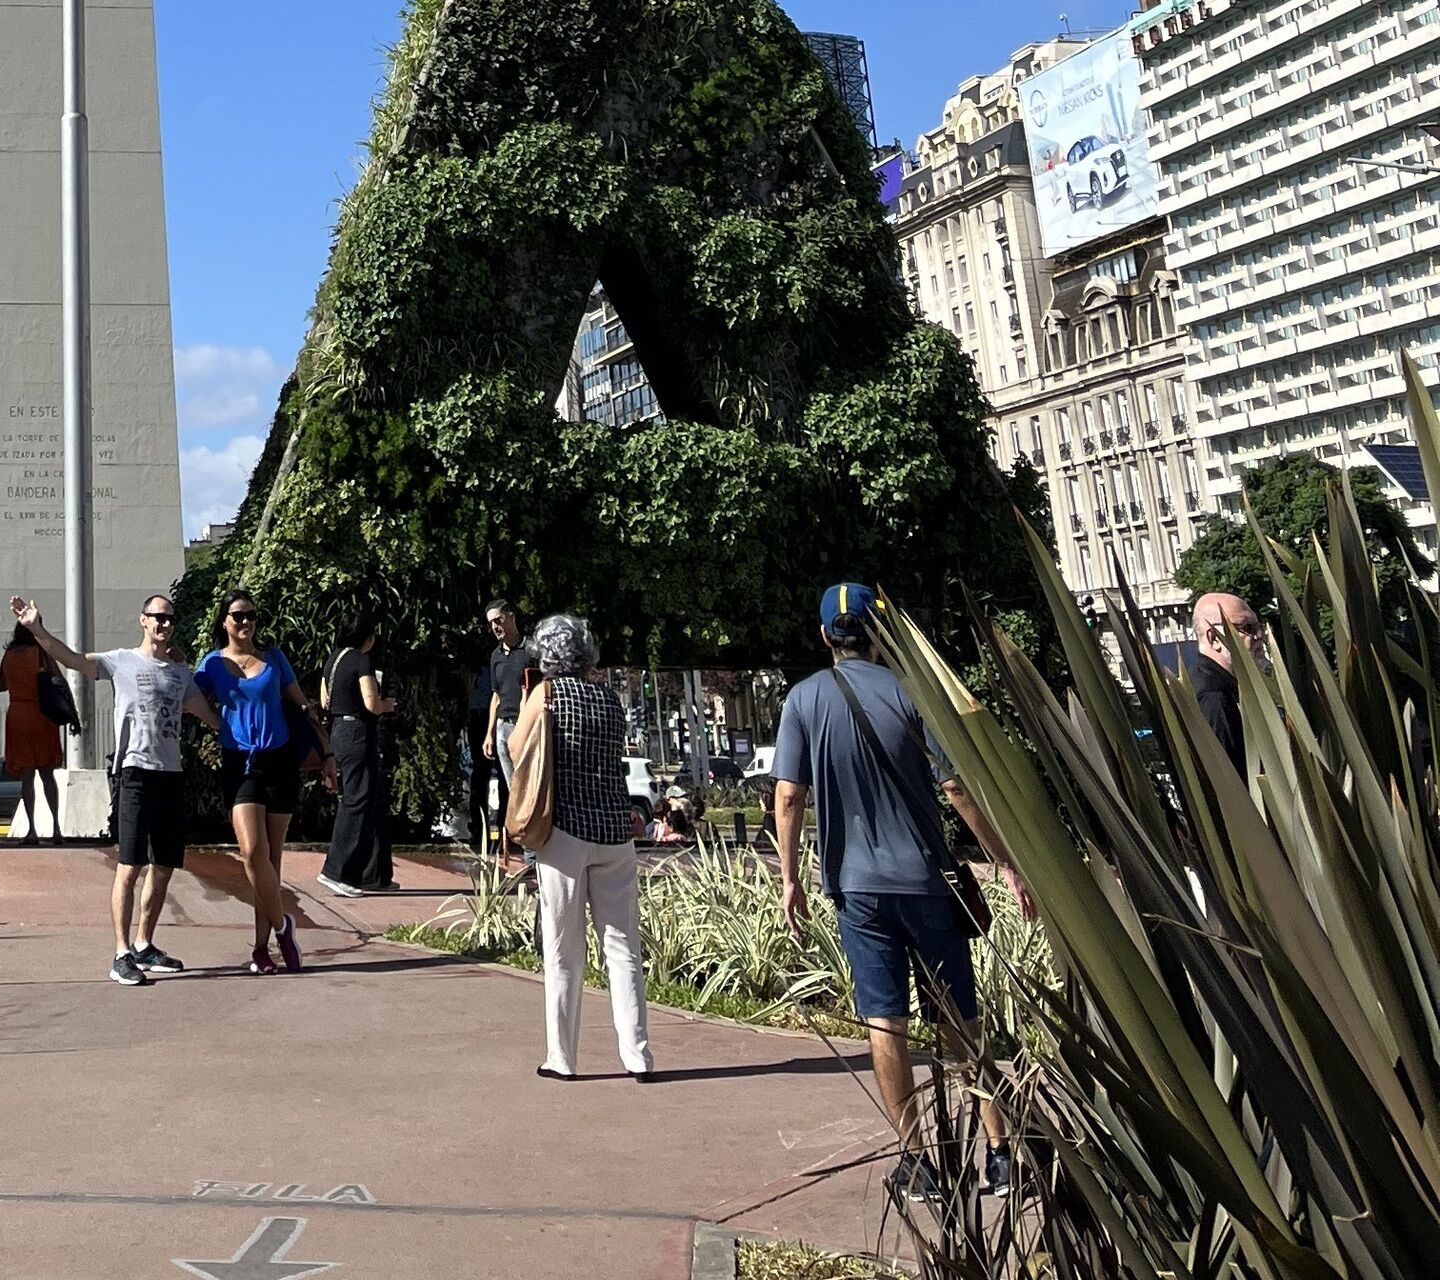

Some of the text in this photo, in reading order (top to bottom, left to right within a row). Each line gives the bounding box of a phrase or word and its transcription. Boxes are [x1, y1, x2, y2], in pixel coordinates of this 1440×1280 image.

[9, 405, 24, 418] EN
[30, 405, 59, 418] ESTE
[2, 434, 13, 442] LA
[49, 434, 59, 442] DE
[98, 451, 114, 460] VEZ
[23, 470, 35, 478] EN
[38, 470, 49, 478] LA
[7, 486, 56, 499] BANDERA
[3, 511, 14, 520] EL
[39, 511, 50, 520] DE
[191, 1178, 377, 1205] FILA
